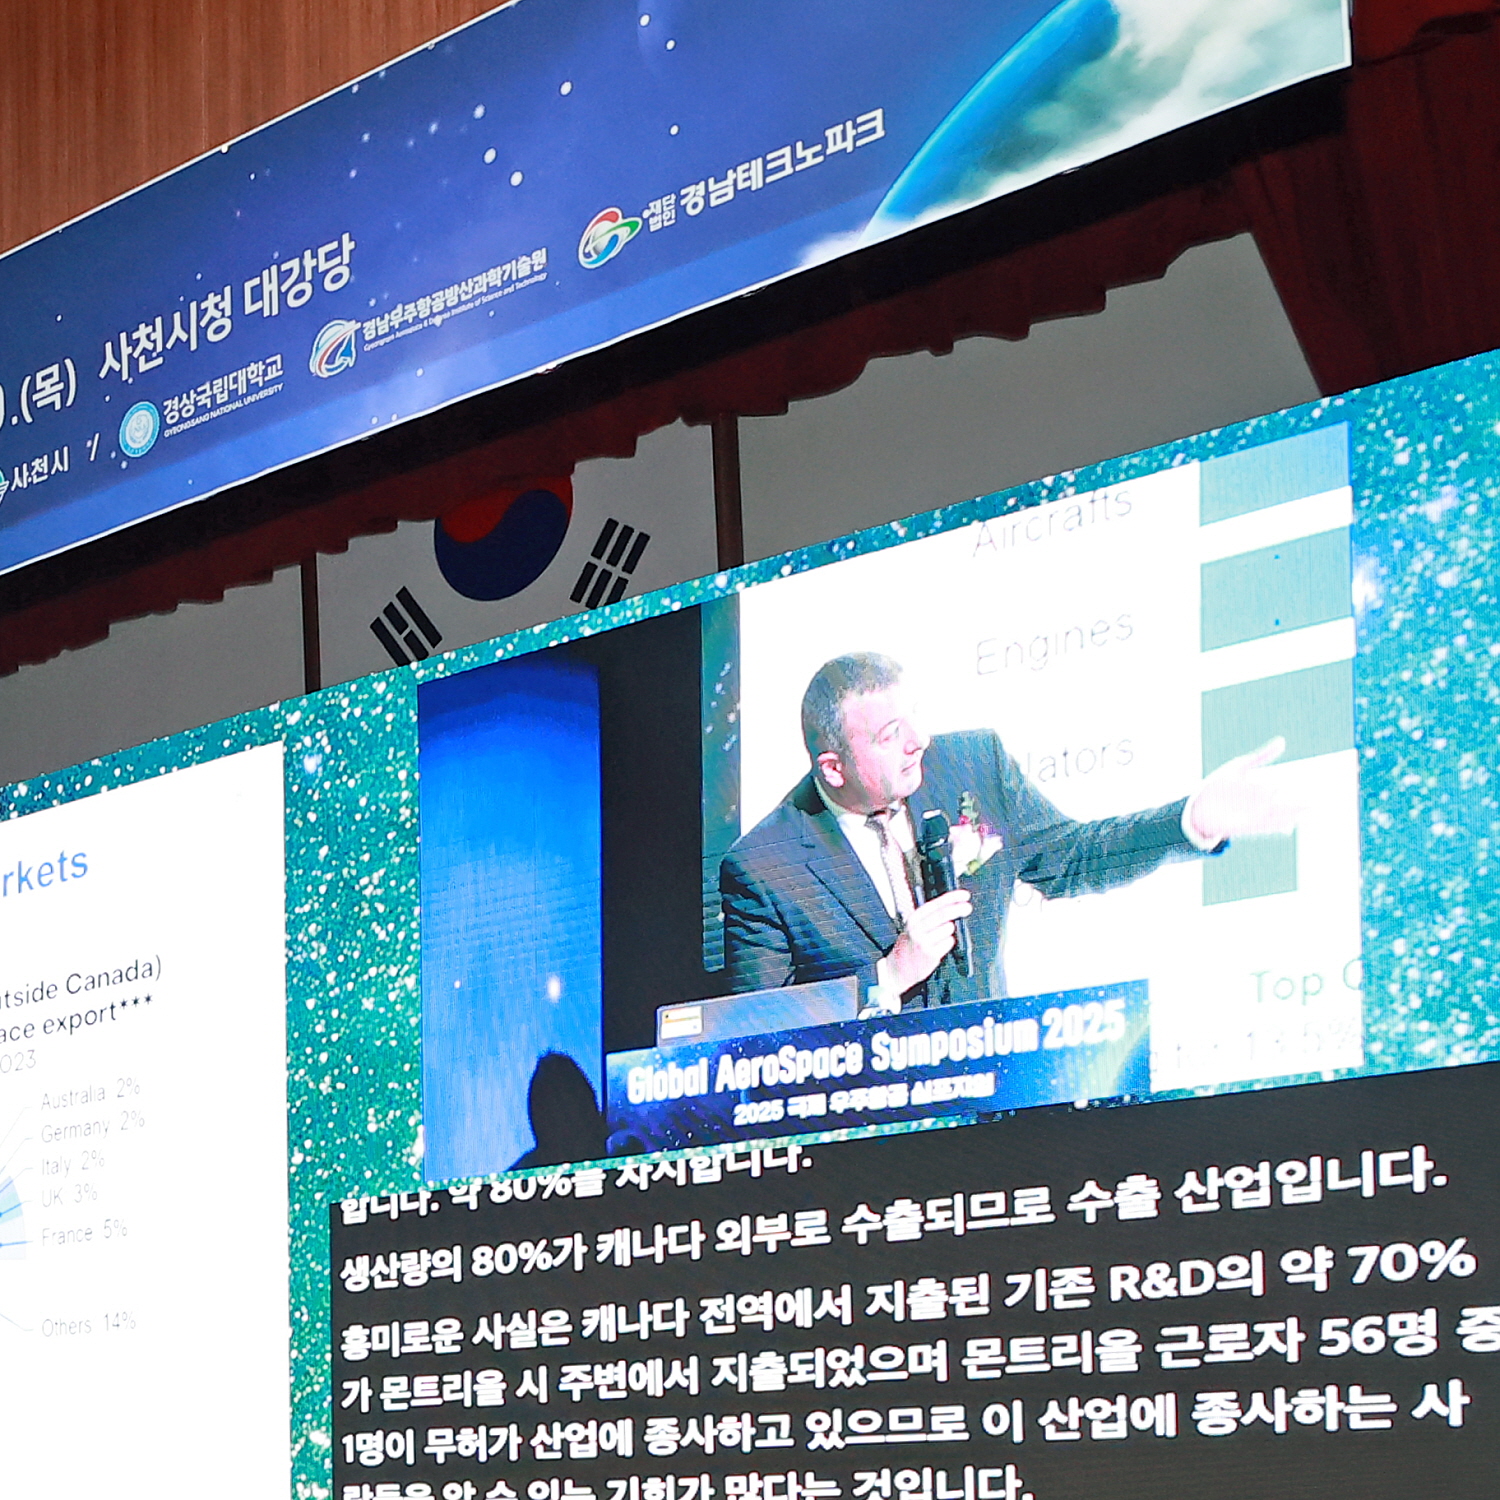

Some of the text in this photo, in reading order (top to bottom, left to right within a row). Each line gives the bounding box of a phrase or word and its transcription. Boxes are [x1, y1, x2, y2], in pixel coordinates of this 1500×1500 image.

[680, 107, 885, 216] 경남테크노파크
[98, 232, 355, 381] 사천시청 대강당
[10, 353, 284, 491] 사천시 경상국립대학교
[973, 490, 1133, 558] Aircrafts
[975, 611, 1135, 679] Engines
[65, 954, 163, 995] Canada)
[1250, 970, 1324, 1006] Top
[627, 1000, 1127, 1104] Global AeroSpace Symposium 2025
[41, 1076, 141, 1111] Australia 2%
[733, 1103, 783, 1127] 2025
[41, 1110, 146, 1144] Germany 2%
[41, 1149, 105, 1178] Italy 2%
[41, 1182, 99, 1208] UK 3%
[340, 1145, 1448, 1292] 생산량의 80%가 캐나다 외부로 수출되므로 수출 산업입니다.
[41, 1218, 129, 1247] France 5%
[41, 1311, 137, 1337] Others 14%
[340, 1236, 1477, 1362] 흥미로운 사실은 캐나다 전역에서 지출된 기존 R&D의 약 70%
[340, 1377, 373, 1415] 가
[515, 1365, 549, 1404] 시
[558, 1356, 700, 1403] 주변에서
[711, 1339, 949, 1392] 지출되었으며
[961, 1327, 1143, 1381] 몬트리올
[1154, 1316, 1306, 1370] 근로자
[1318, 1306, 1439, 1359] 56명
